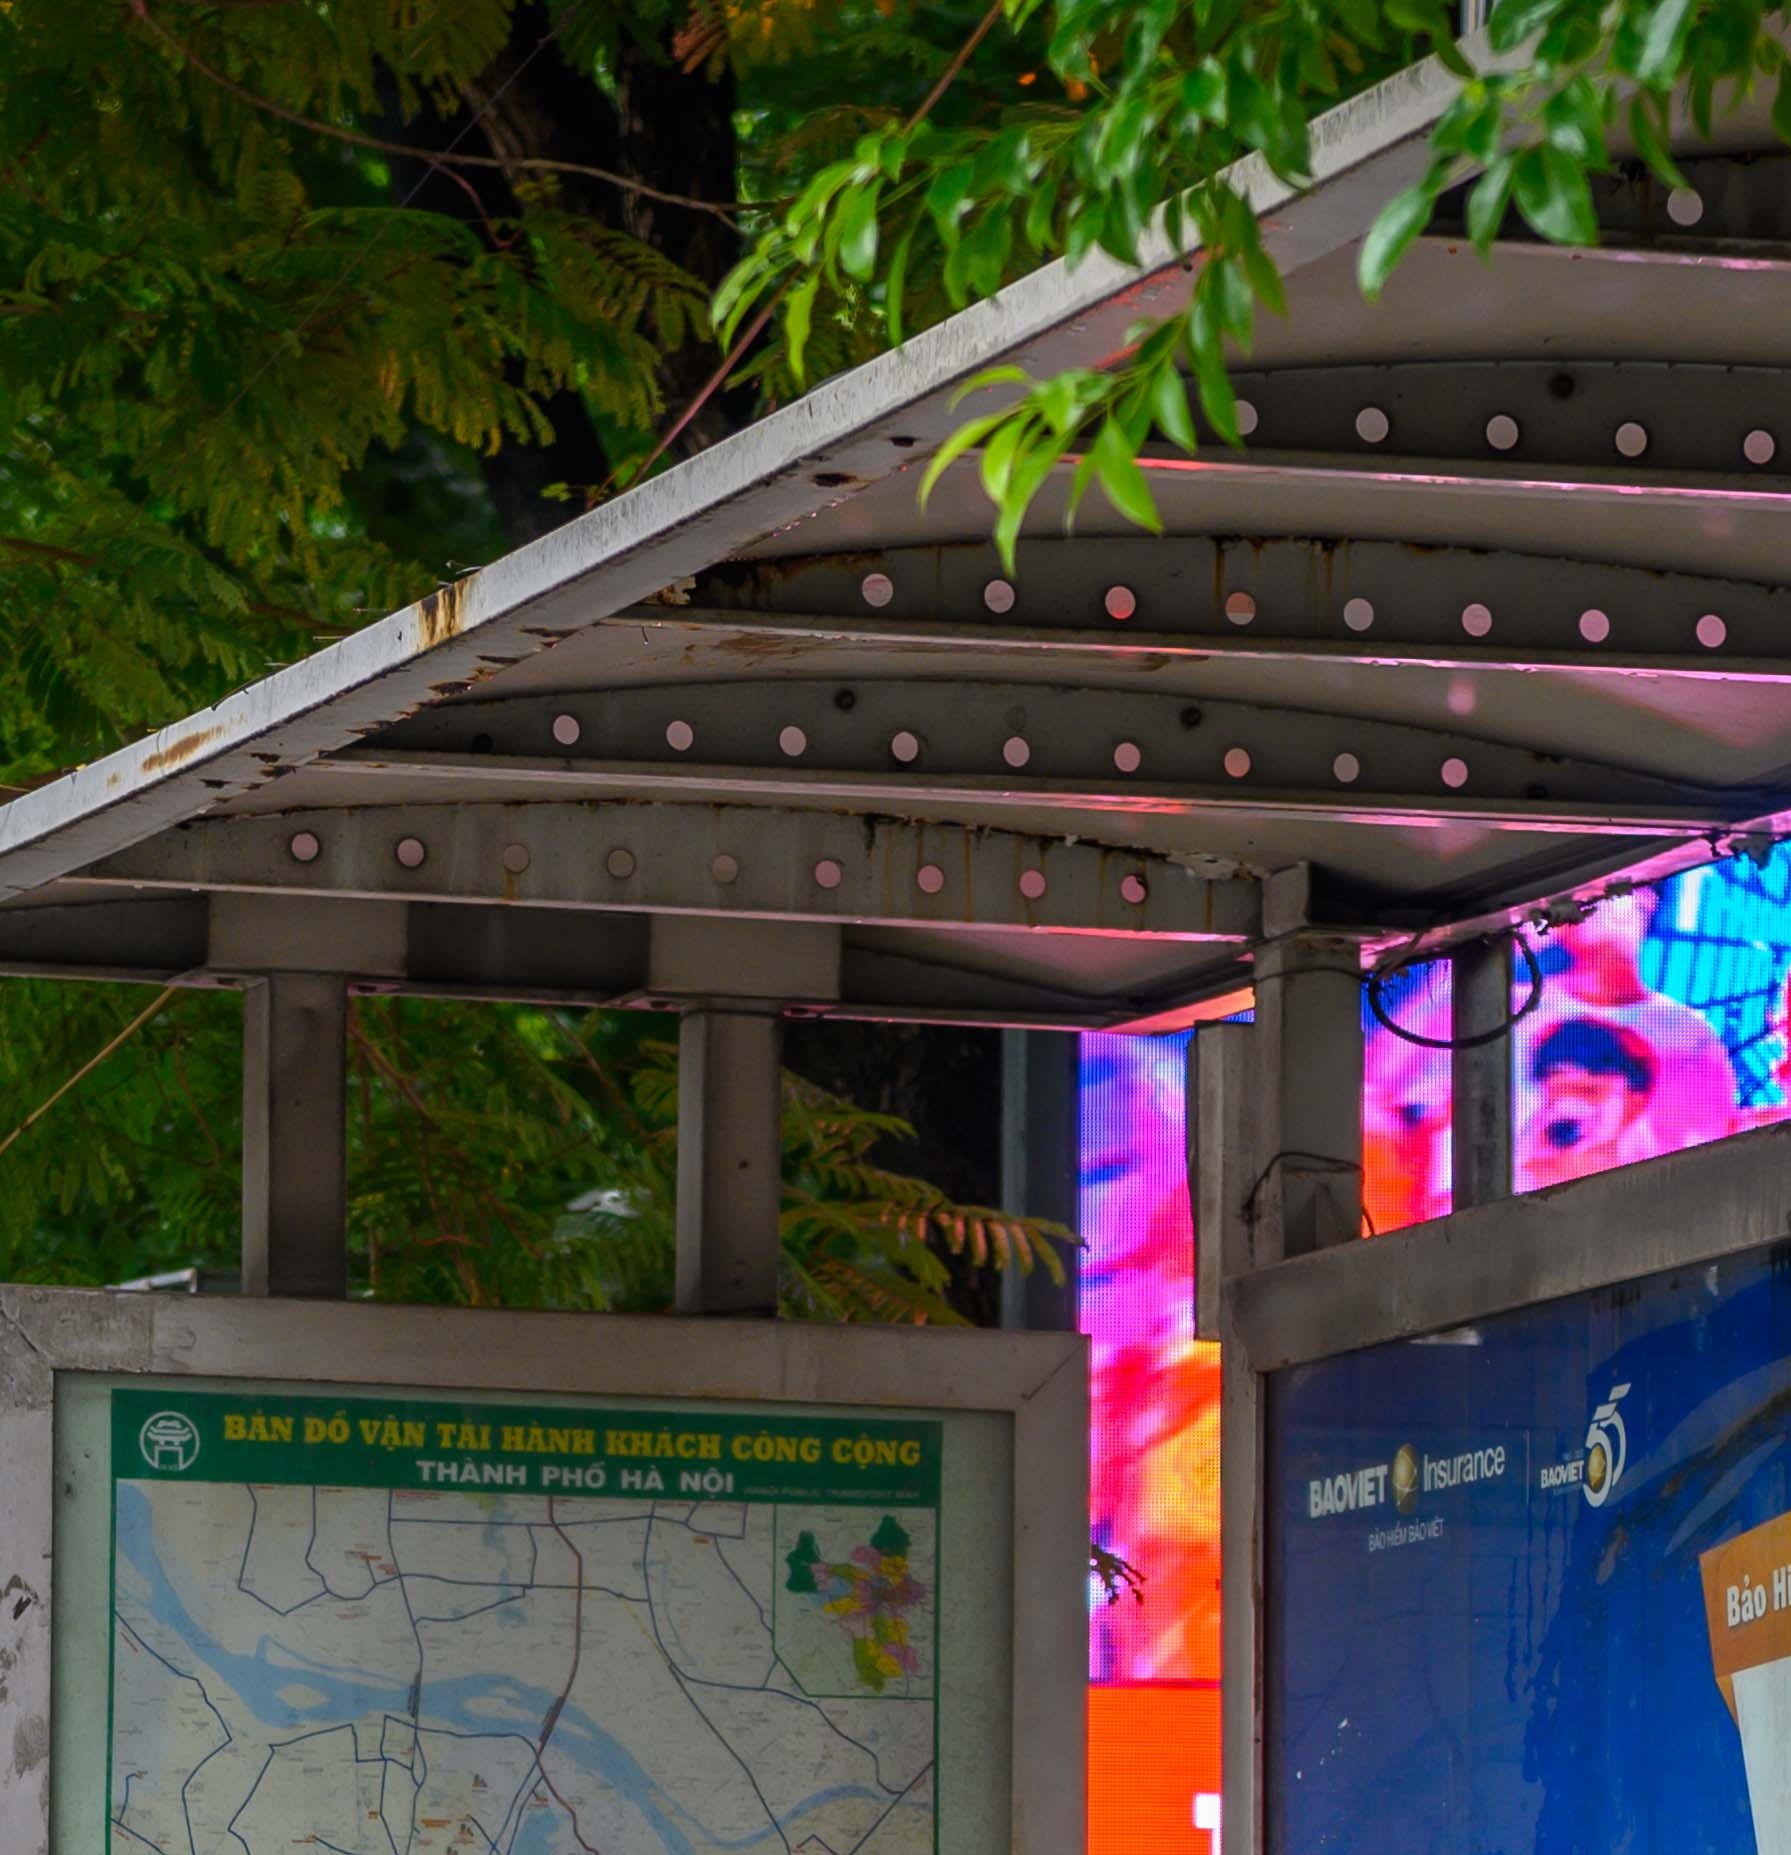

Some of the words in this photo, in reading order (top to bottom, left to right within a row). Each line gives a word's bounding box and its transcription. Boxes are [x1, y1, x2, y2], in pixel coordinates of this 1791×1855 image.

[224, 1410, 294, 1443] BẢN
[360, 1414, 425, 1452] VẬN
[436, 1418, 491, 1451] TẢI
[501, 1420, 595, 1455] HÀNH
[606, 1426, 722, 1459] KHÁCH
[731, 1430, 821, 1463] CÔNG
[832, 1434, 921, 1469] CỘNG
[416, 1456, 527, 1485] THÀNH
[541, 1461, 607, 1489] PHỐ
[620, 1464, 665, 1492] HÀ
[680, 1466, 734, 1499] NỘI
[1309, 1464, 1388, 1519] BAOVIET
[1423, 1445, 1505, 1491] Insurance
[1540, 1460, 1584, 1489] BAOVIET
[1726, 1574, 1767, 1627] Bảo
